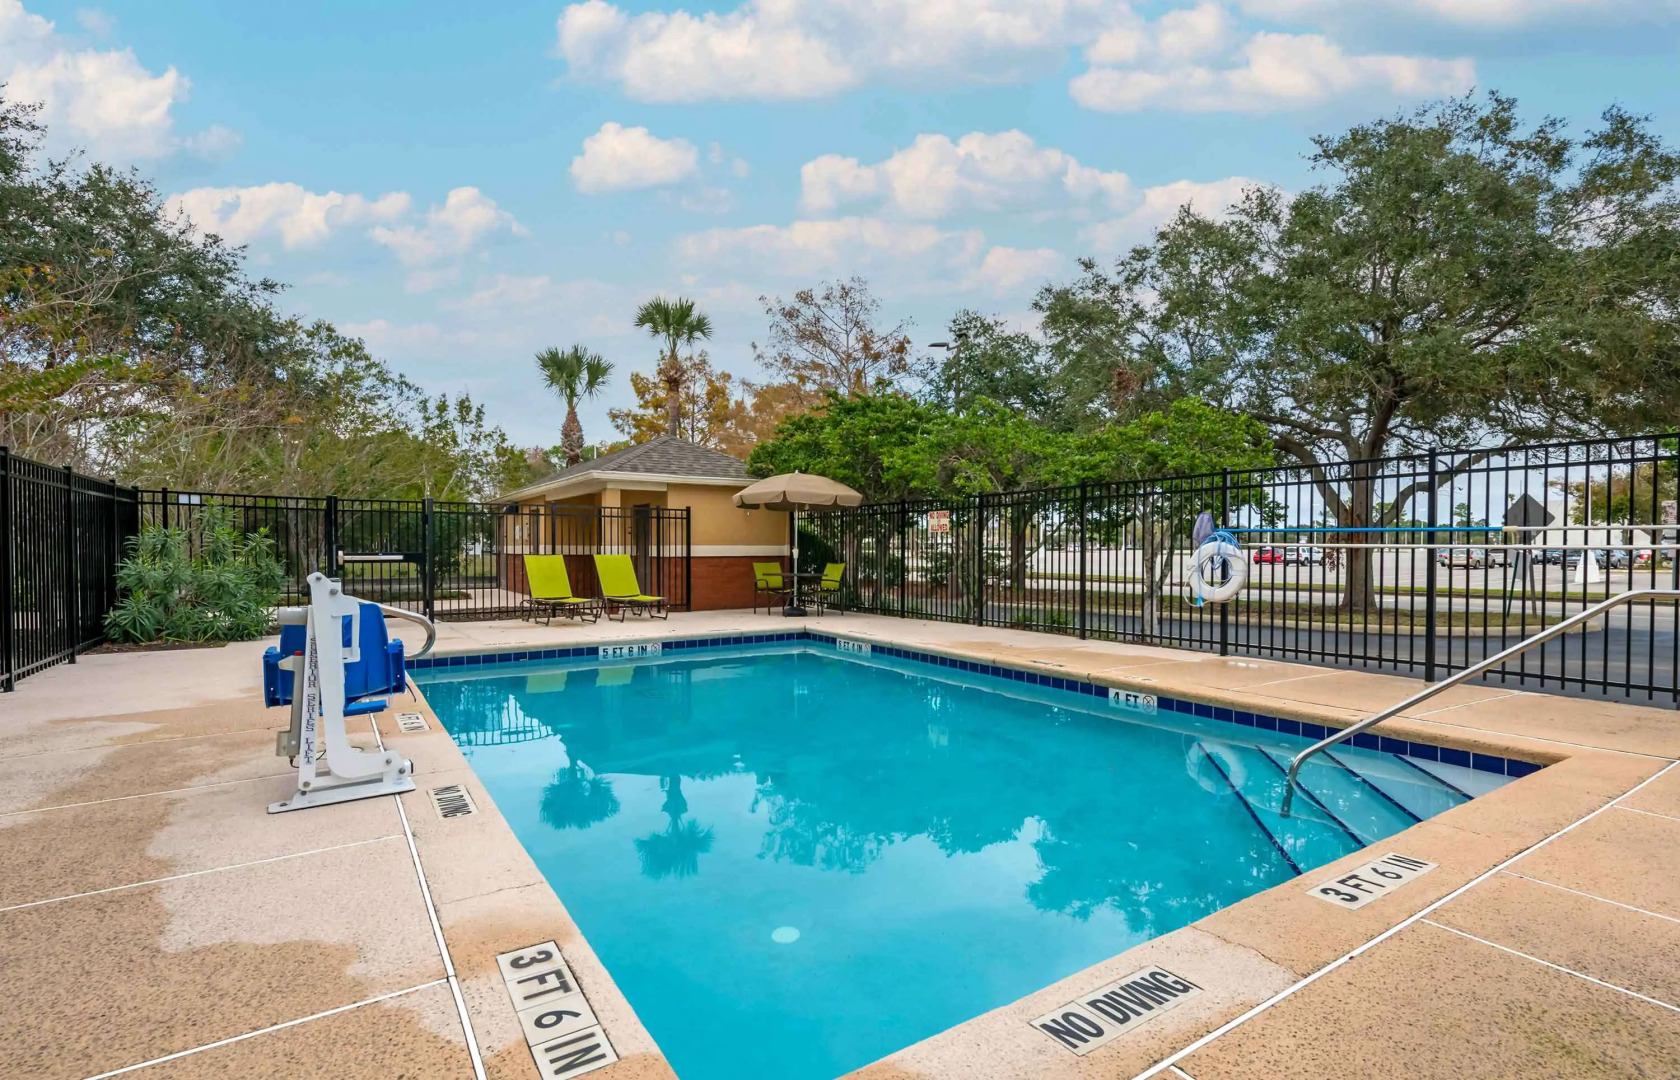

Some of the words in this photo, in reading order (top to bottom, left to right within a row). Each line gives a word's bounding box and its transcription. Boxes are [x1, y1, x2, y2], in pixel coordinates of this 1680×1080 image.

[305, 693, 316, 732] SERIES
[303, 737, 314, 765] LIFT
[432, 785, 461, 796] NO
[436, 795, 473, 818] DIVING
[1381, 854, 1429, 872] IN
[1371, 867, 1403, 880] 6
[1336, 874, 1386, 894] FT
[1320, 887, 1359, 903] 3
[509, 950, 553, 970] 3
[516, 968, 573, 1001] FT
[534, 1009, 583, 1029] 6
[1039, 1011, 1105, 1050] NO
[1085, 971, 1194, 1025] DIVING
[543, 1031, 607, 1076] IN
